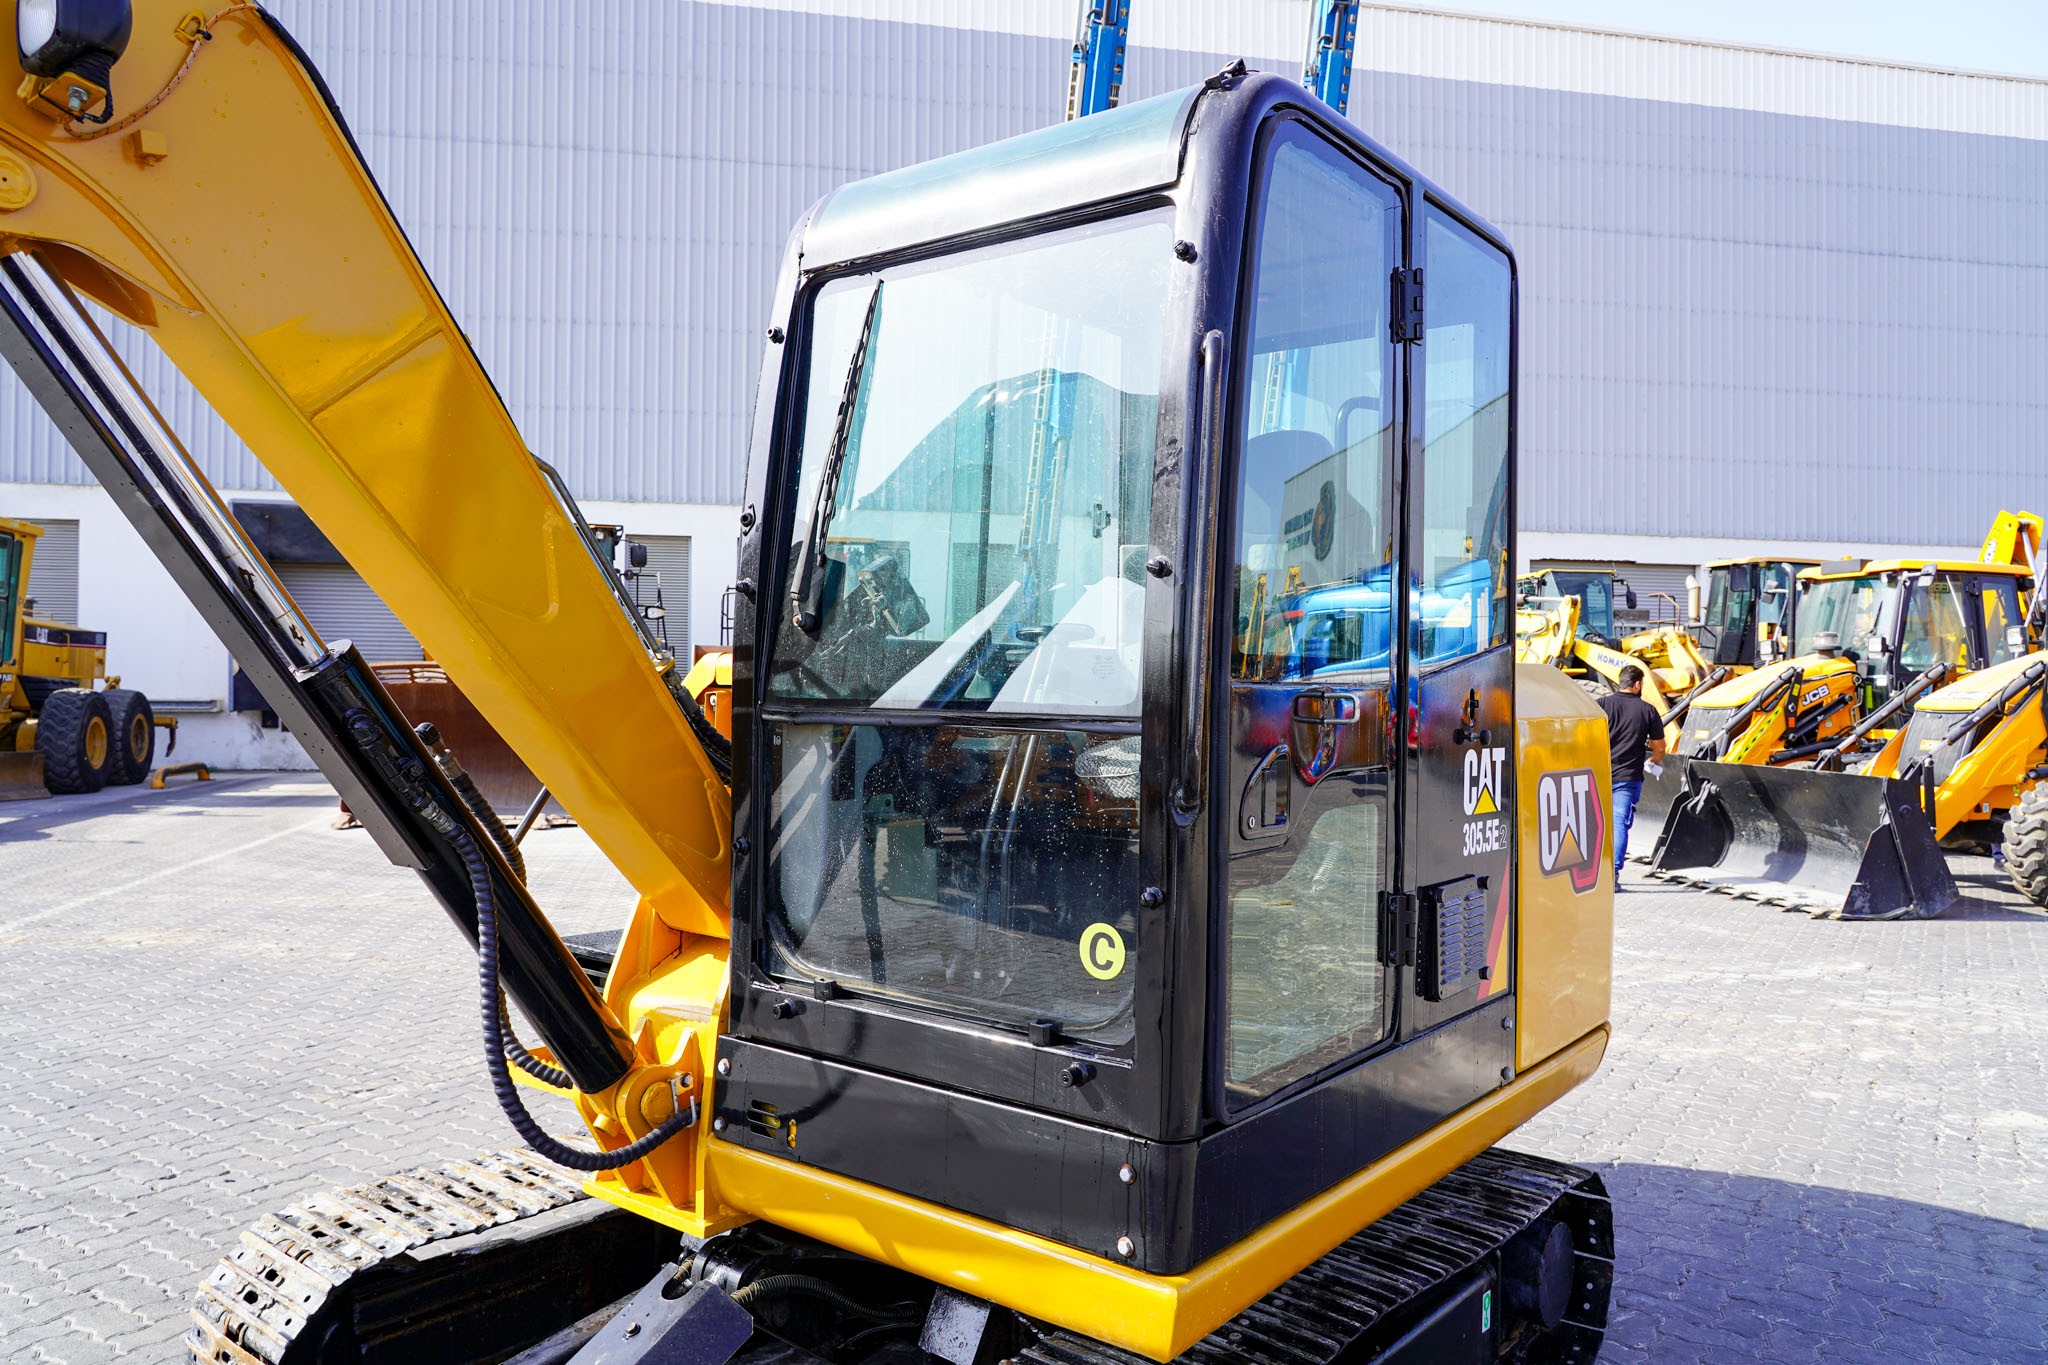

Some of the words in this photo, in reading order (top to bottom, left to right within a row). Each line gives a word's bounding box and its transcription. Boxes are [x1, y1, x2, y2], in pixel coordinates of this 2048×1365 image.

[1802, 684, 1830, 706] JCB
[1464, 747, 1506, 816] CAT
[1463, 818, 1508, 857] 305.5E2
[1539, 774, 1589, 871] CAT
[1089, 932, 1115, 970] C
